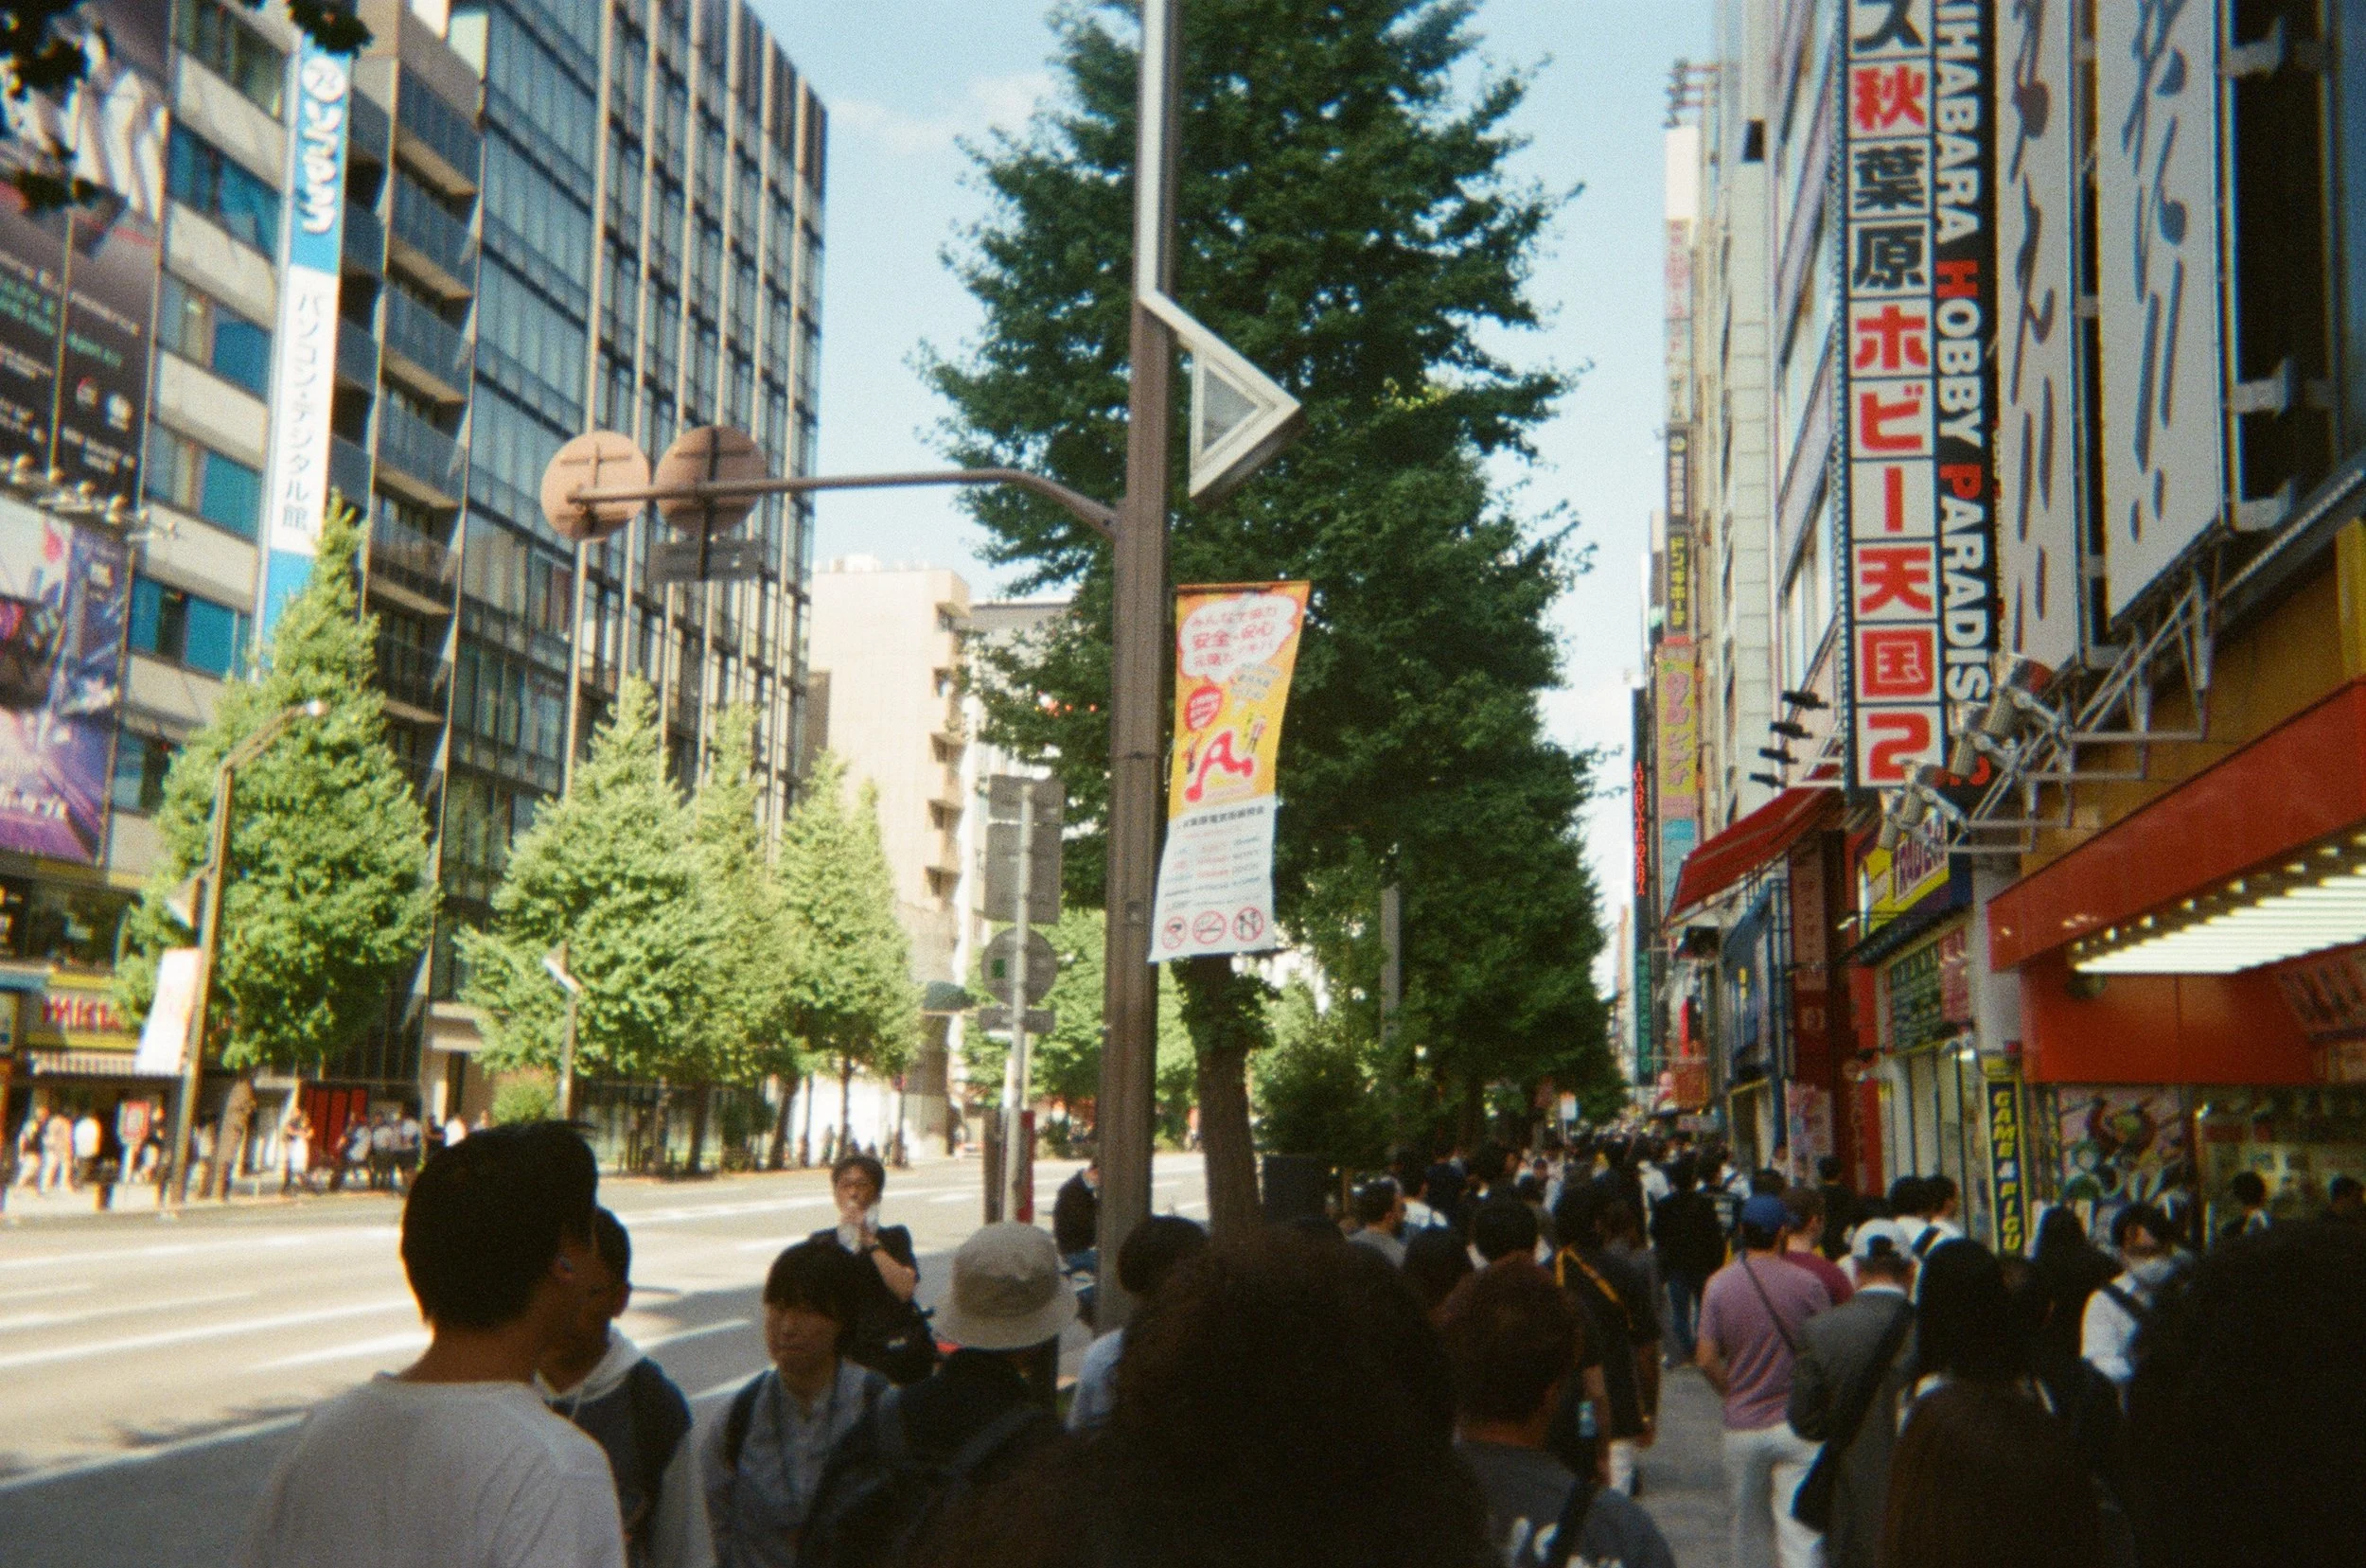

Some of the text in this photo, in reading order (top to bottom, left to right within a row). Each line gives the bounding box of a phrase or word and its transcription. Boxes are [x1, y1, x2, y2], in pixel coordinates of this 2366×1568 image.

[1935, 0, 1980, 243] IHABARA
[1936, 260, 1982, 446] HOBBY
[1994, 1091, 2016, 1158] GAME
